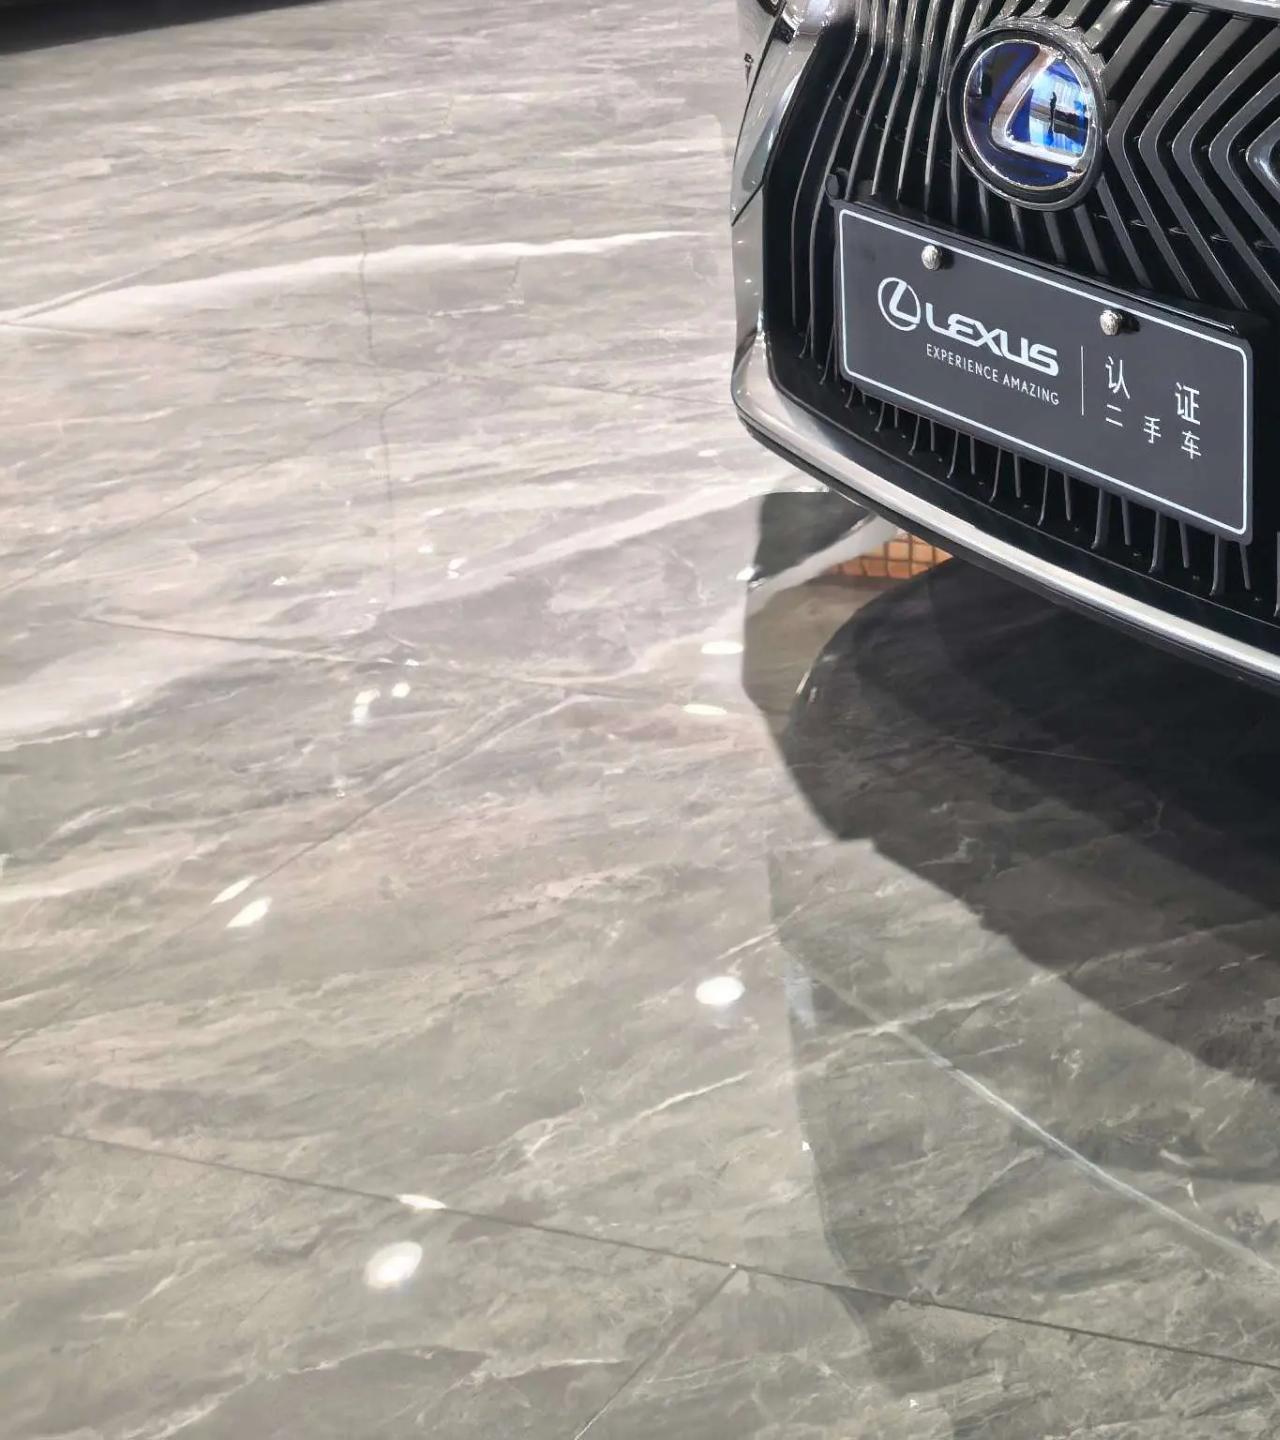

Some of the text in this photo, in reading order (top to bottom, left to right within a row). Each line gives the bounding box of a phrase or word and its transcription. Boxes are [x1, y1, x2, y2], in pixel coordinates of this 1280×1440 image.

[925, 302, 1059, 376] LEXUS
[926, 343, 1060, 405] EXPERIENCE AMAZING
[1105, 356, 1201, 425] 认证
[1105, 404, 1201, 459] 二手车
